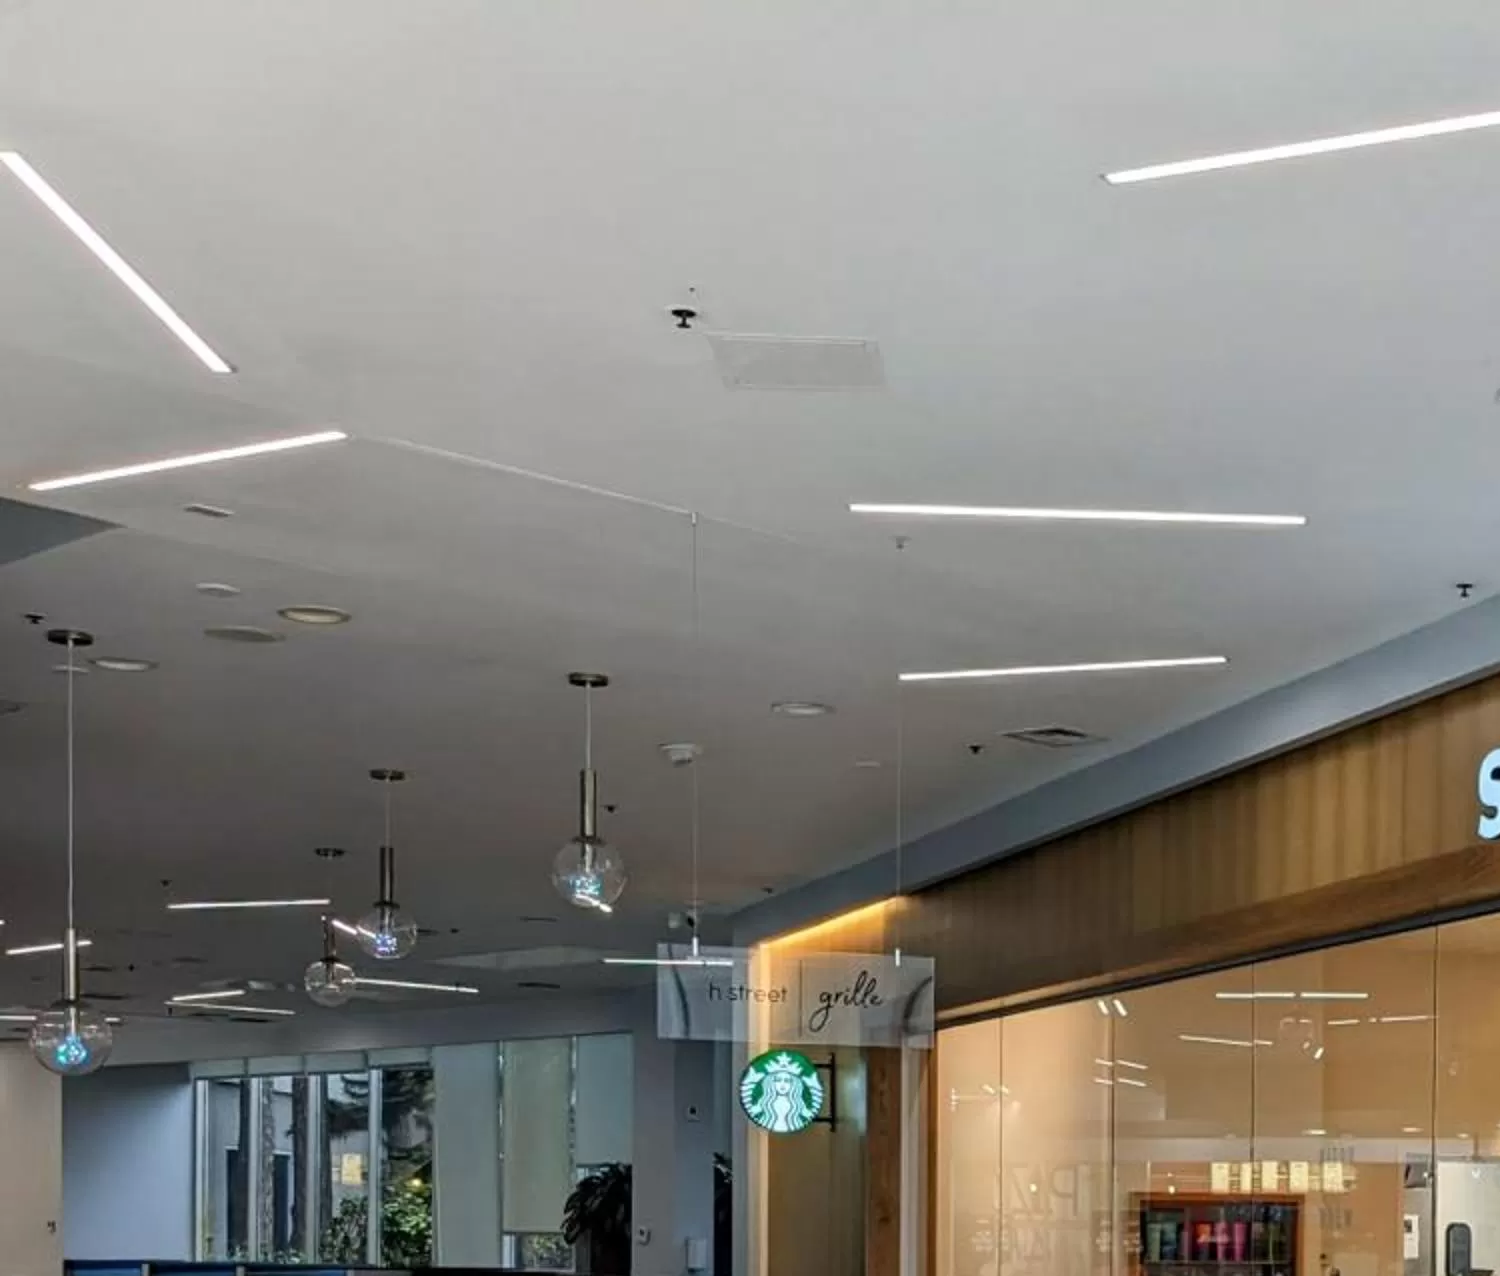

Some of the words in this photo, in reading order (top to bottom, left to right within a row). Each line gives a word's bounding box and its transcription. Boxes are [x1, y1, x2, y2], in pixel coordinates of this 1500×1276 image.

[708, 980, 723, 1002] h
[727, 984, 788, 1004] street
[808, 969, 884, 1033] grille
